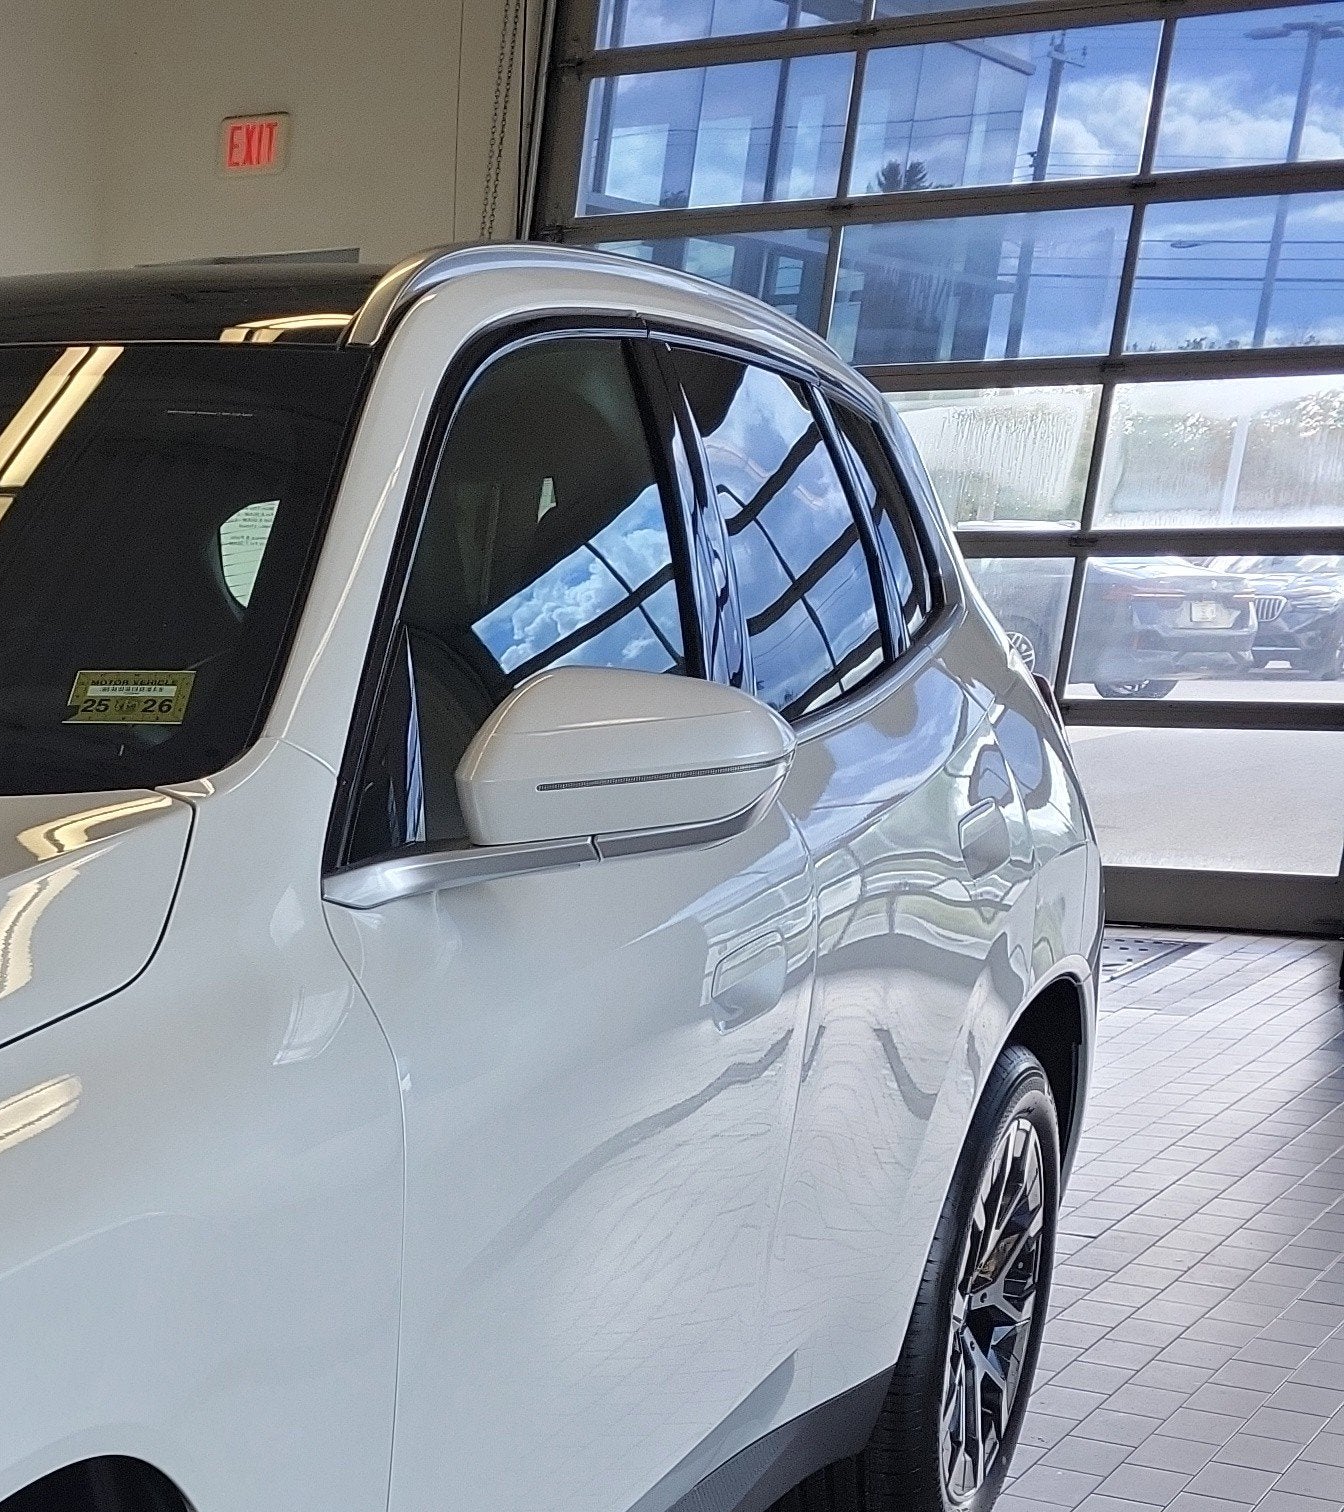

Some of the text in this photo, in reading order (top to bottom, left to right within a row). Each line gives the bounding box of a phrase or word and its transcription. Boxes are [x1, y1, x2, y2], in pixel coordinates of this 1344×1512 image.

[227, 122, 278, 167] EXIT
[80, 698, 174, 713] 25 26
